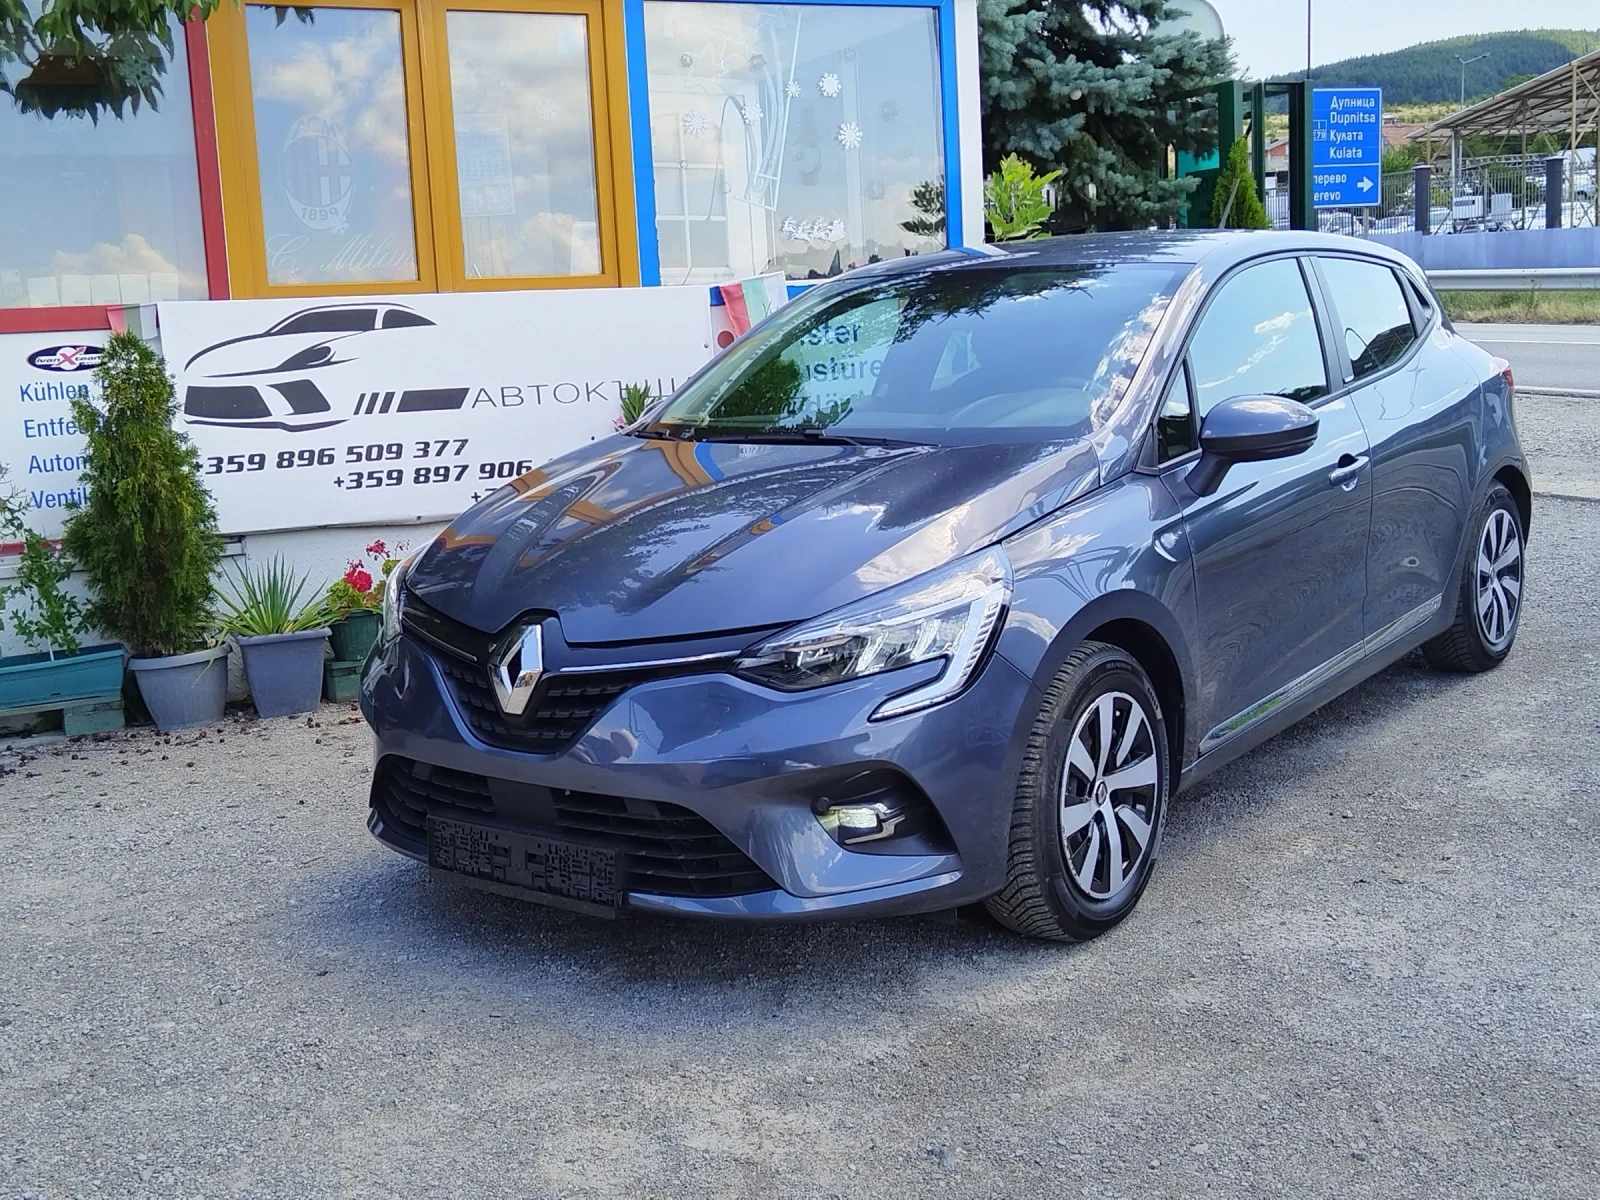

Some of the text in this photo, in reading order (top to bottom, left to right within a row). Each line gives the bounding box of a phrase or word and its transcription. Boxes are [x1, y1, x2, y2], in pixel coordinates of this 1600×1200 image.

[1330, 96, 1375, 111] Дупница
[1330, 111, 1376, 126] Dupnitsa
[1329, 129, 1363, 144] Кулата
[1329, 146, 1363, 159] Kulata
[1313, 190, 1341, 201] erevo
[300, 205, 340, 221] 1899
[320, 231, 416, 272] Milan
[801, 321, 862, 346] ster
[276, 447, 336, 470] 896
[345, 442, 404, 464] 509
[412, 438, 469, 459] 377
[333, 459, 533, 490] +359 897 906
